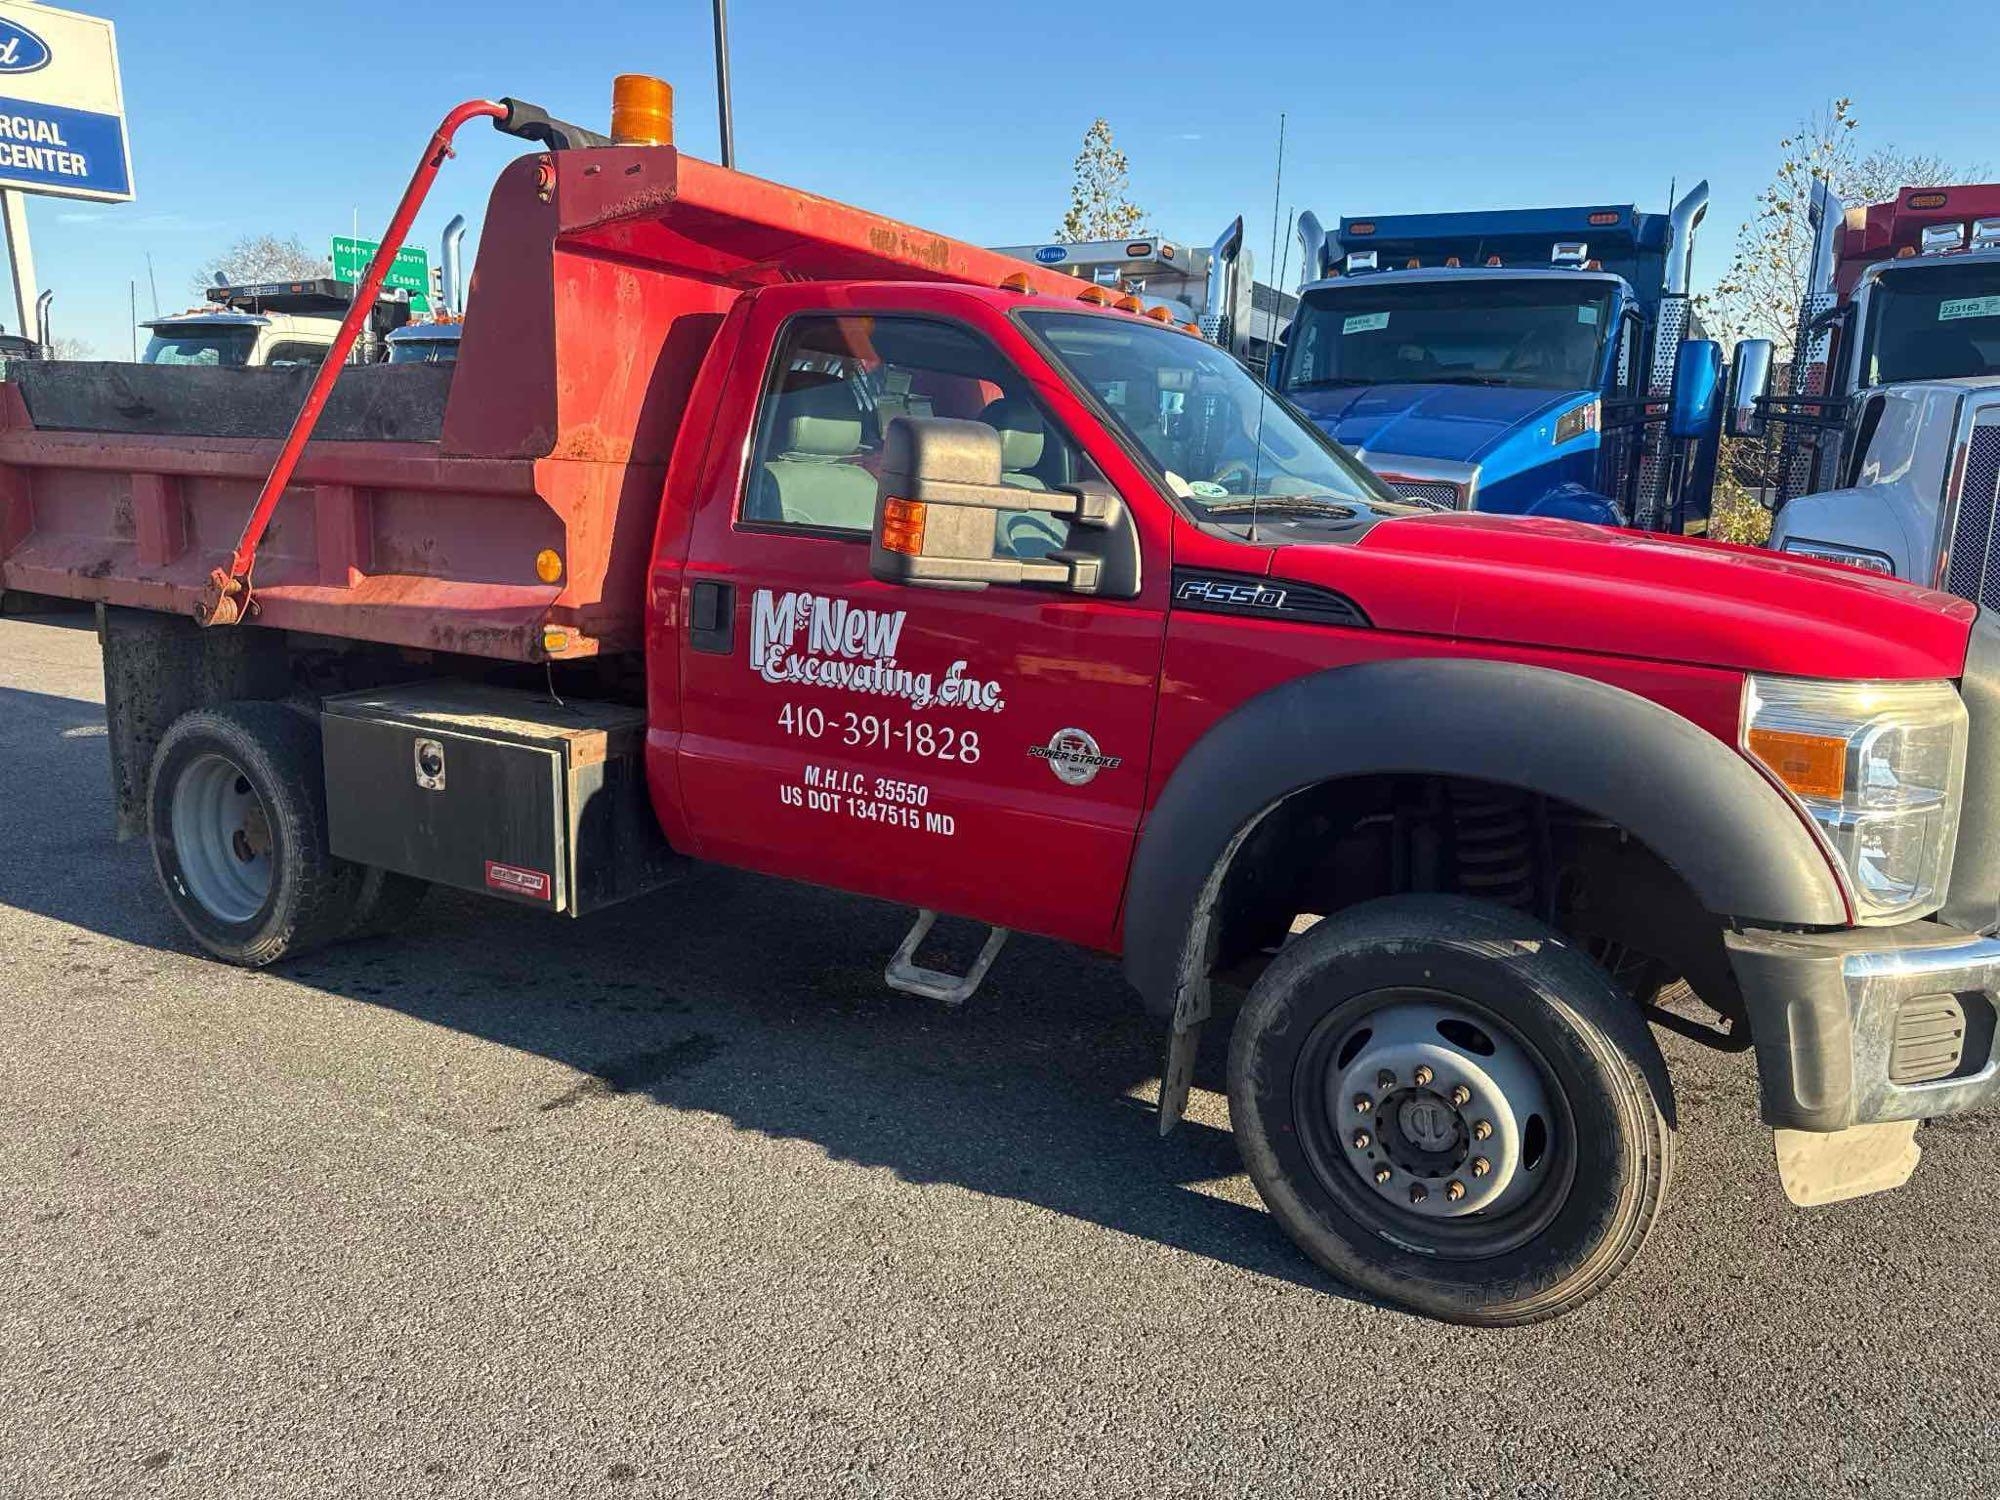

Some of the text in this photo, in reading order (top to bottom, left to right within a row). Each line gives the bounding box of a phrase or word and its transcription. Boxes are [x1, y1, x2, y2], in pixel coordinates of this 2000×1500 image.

[0, 142, 88, 177] CENTER
[750, 589, 906, 671] McNew
[804, 765, 928, 806] M.H.I.C. 35550
[780, 784, 955, 836] US DOT 1347515 MD
